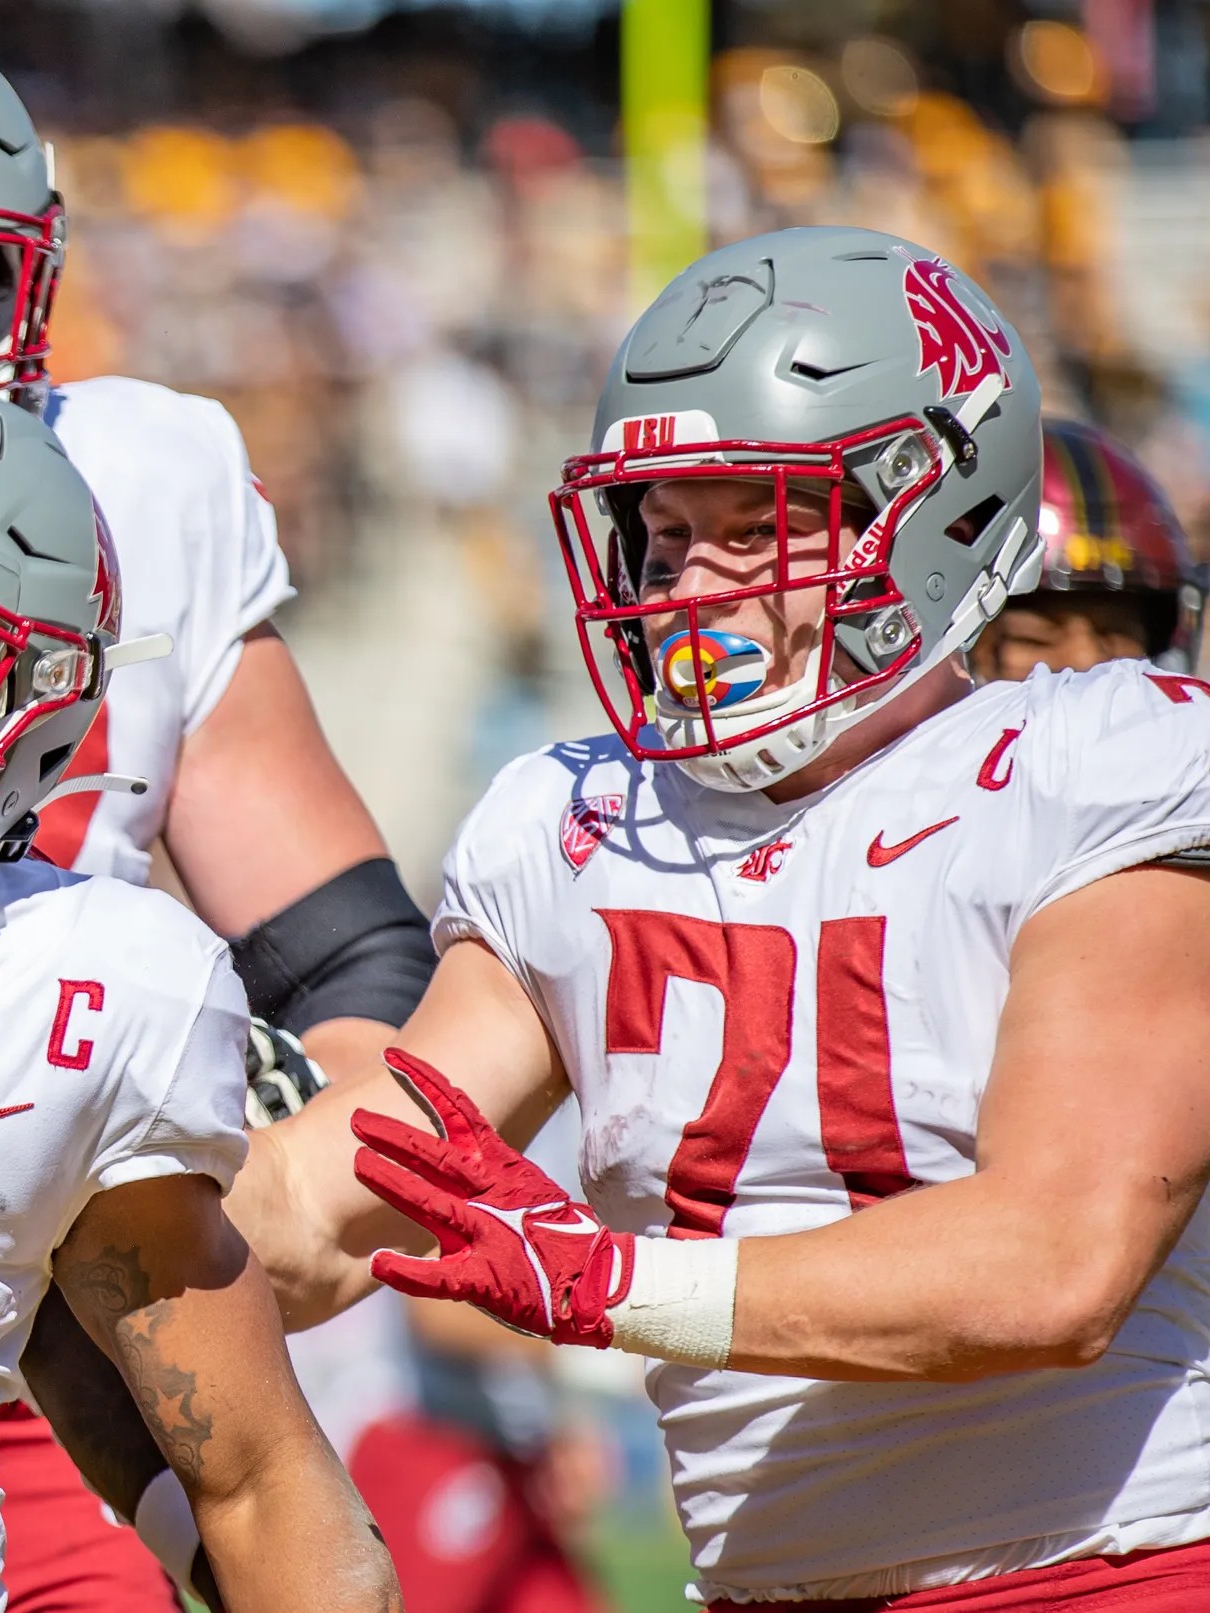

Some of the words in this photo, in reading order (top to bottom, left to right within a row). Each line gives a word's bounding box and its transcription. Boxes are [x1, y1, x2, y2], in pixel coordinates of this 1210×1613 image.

[623, 415, 676, 450] WSU
[47, 978, 106, 1071] C
[592, 908, 924, 1240] 71
